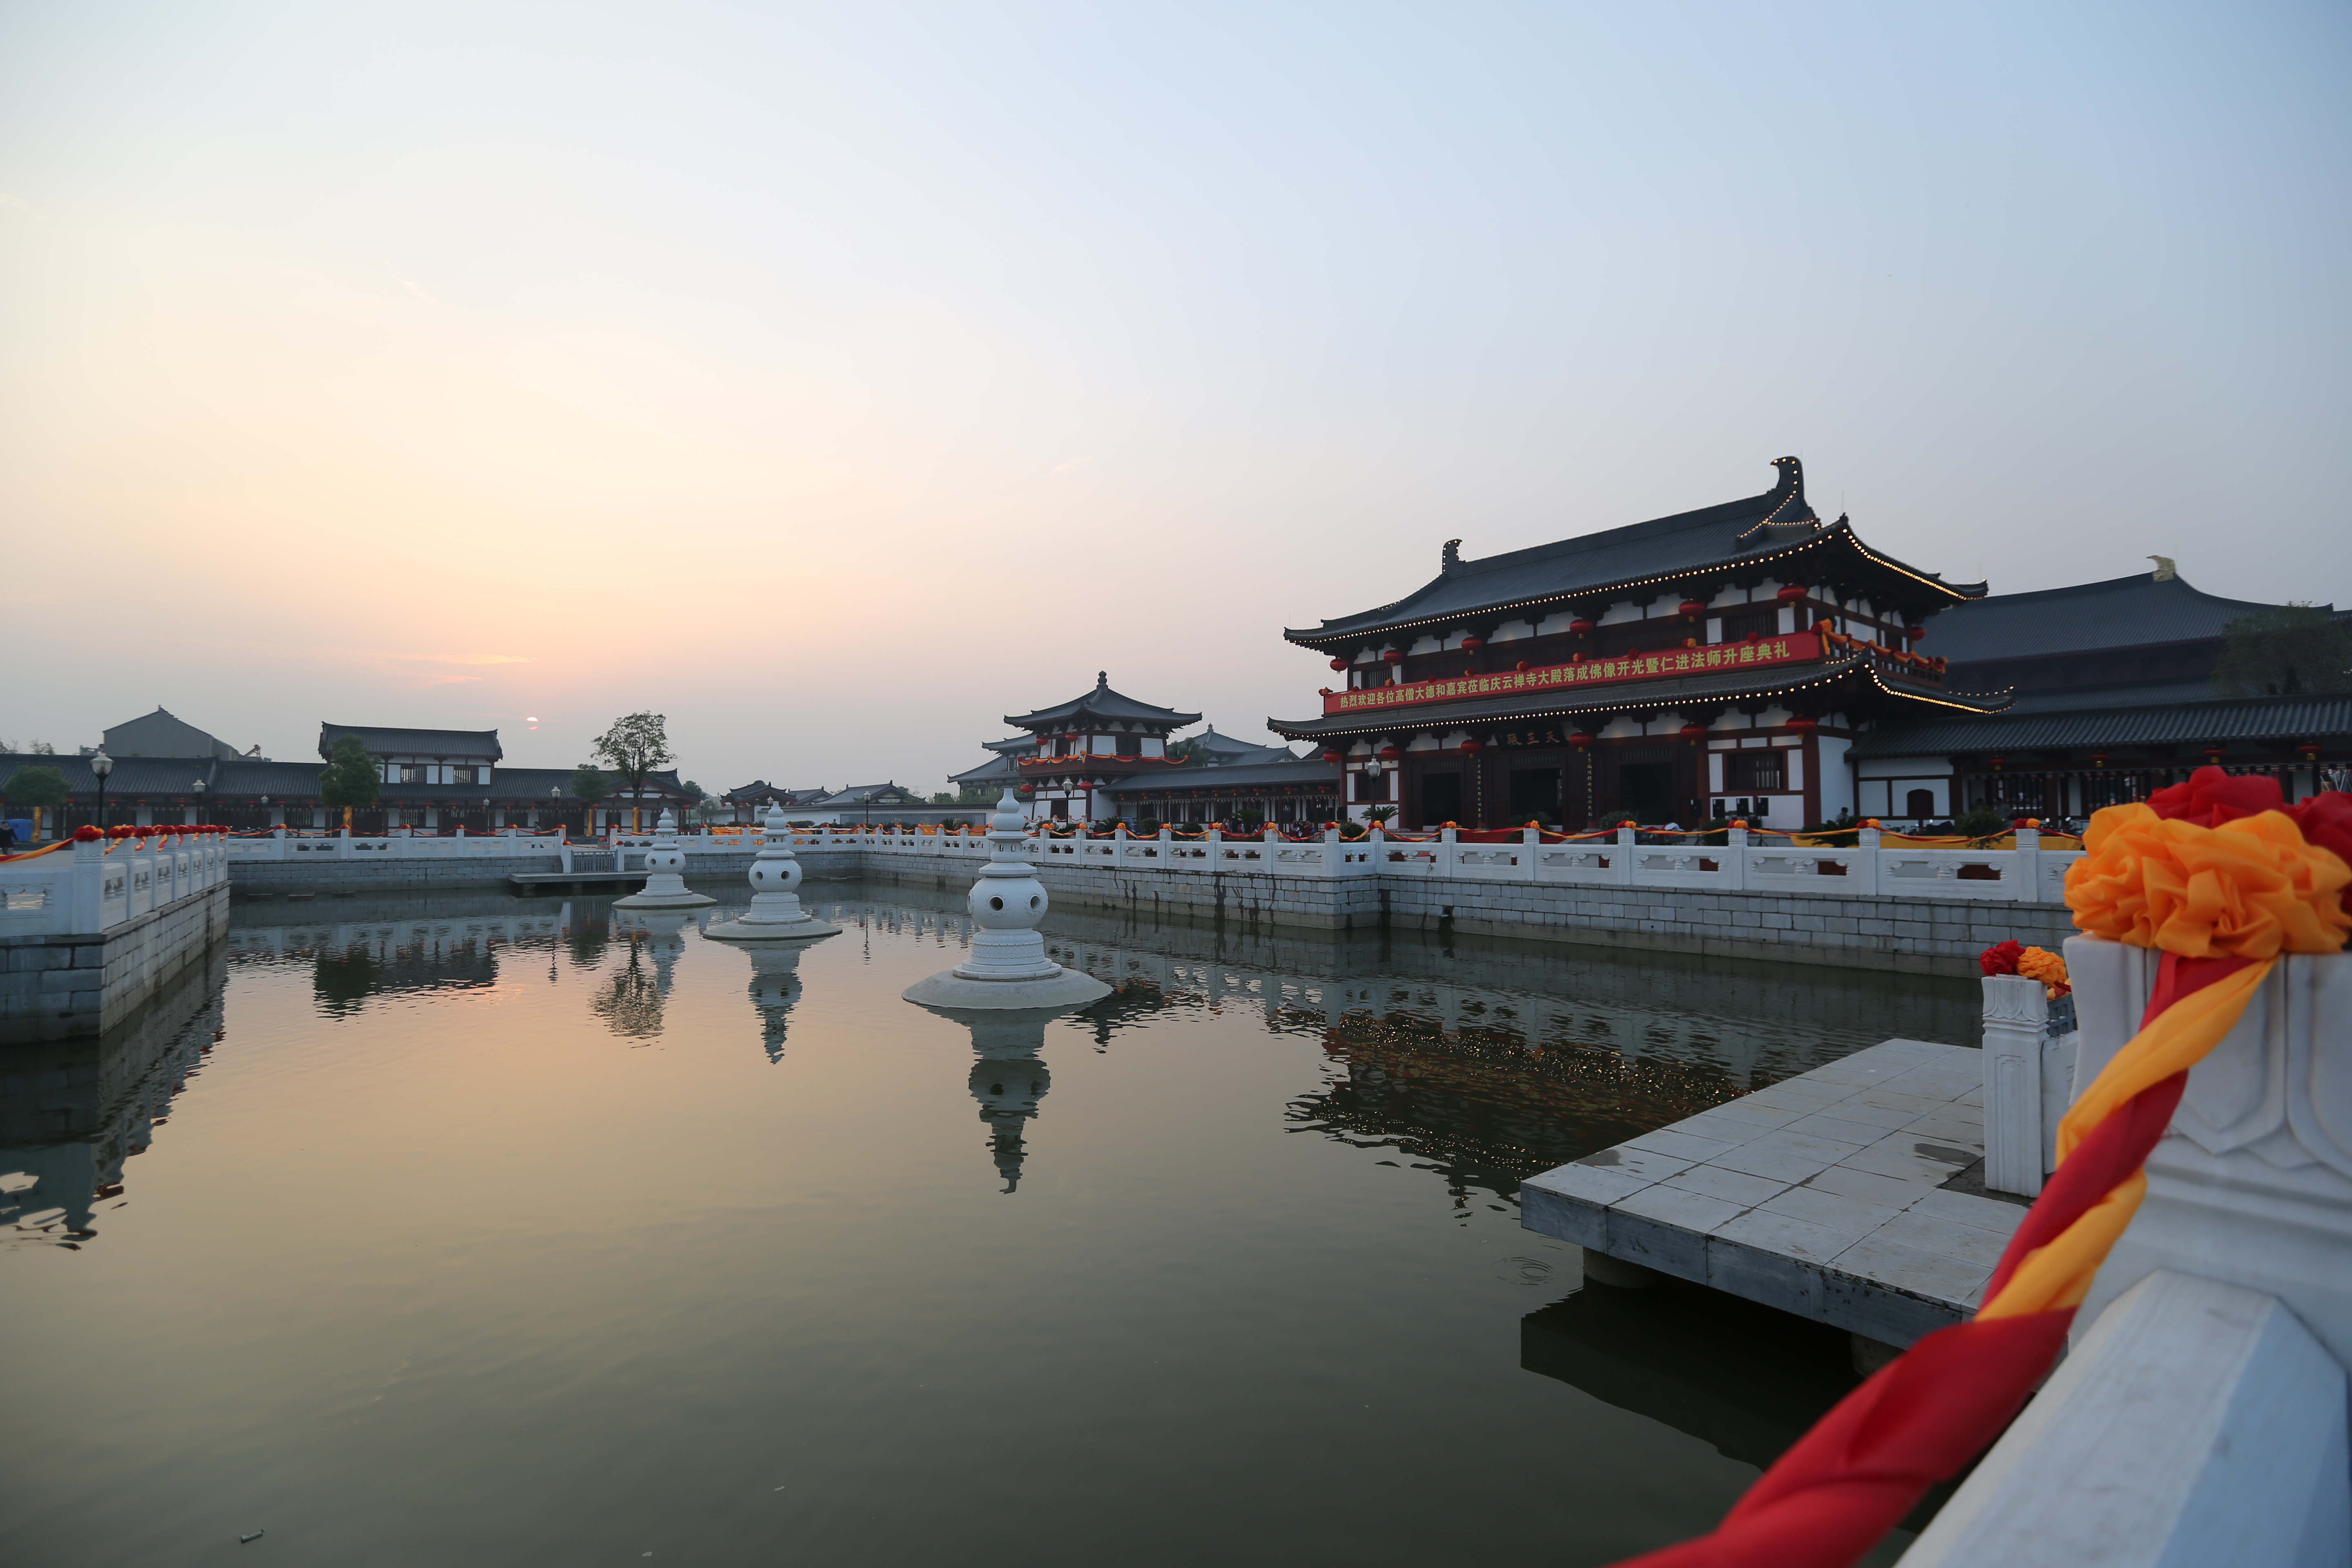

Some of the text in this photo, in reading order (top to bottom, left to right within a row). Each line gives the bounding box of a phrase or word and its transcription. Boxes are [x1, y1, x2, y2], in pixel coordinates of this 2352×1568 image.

[1340, 641, 1790, 708] 热烈欢迎各位高僧大德和嘉宾莅临庆云禅寺大殿落成佛像开光暨仁进法师升座典礼
